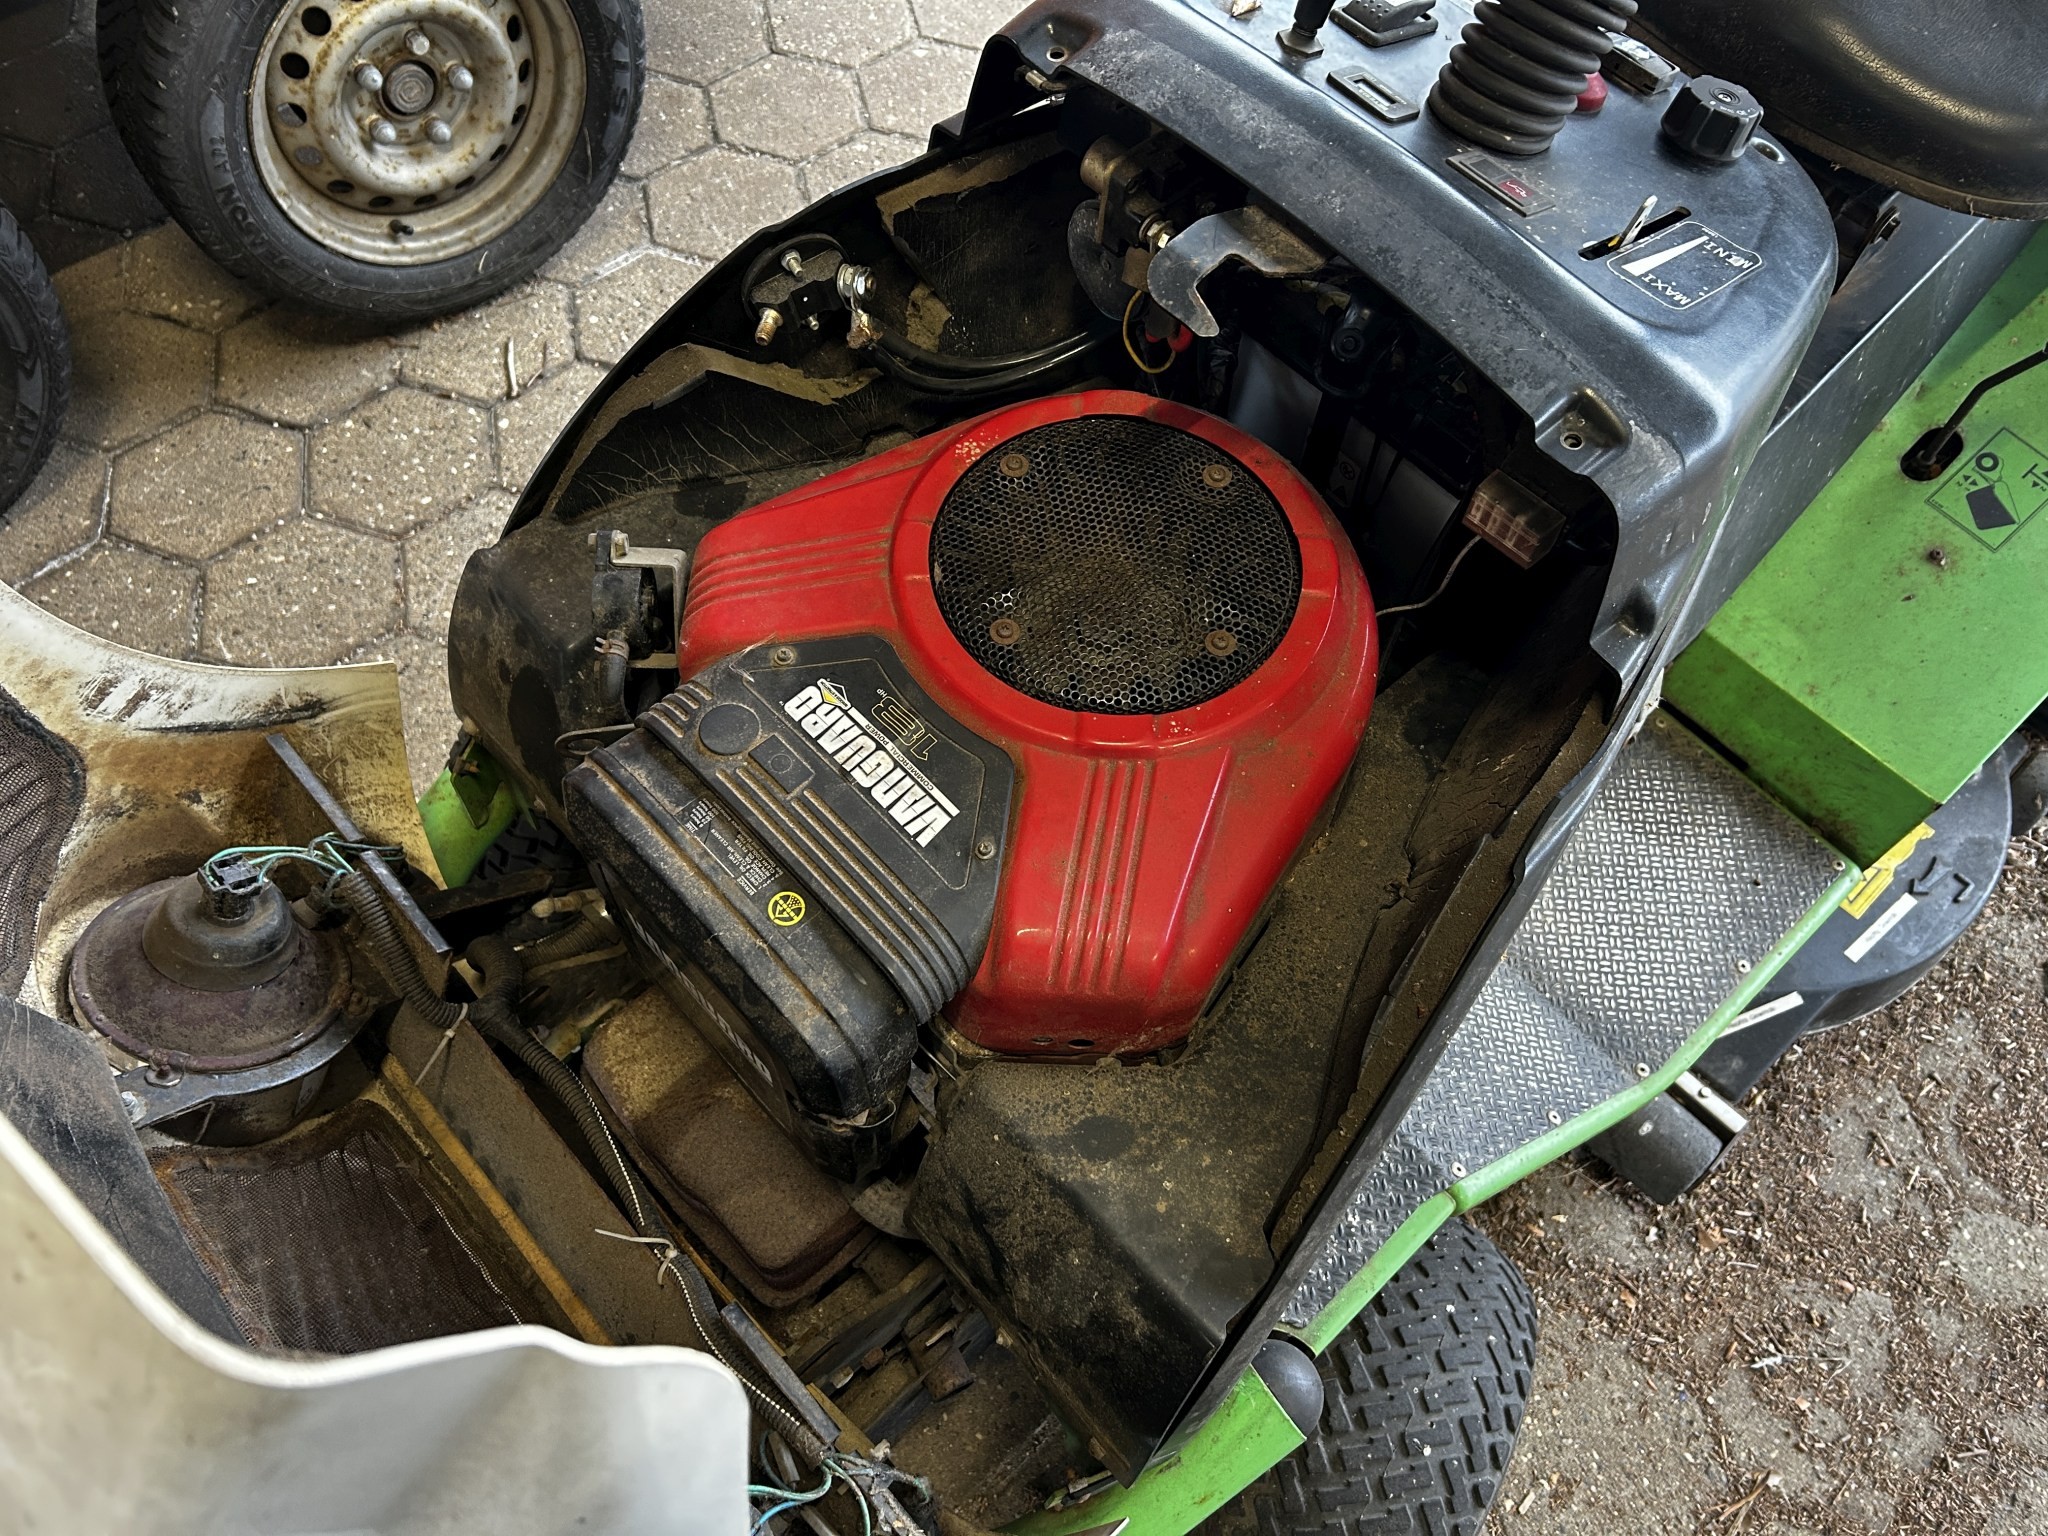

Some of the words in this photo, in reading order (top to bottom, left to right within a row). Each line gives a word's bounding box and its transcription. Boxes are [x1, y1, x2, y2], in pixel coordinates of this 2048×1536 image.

[1703, 240, 1753, 269] MINI
[1641, 273, 1691, 305] MAXI
[876, 688, 888, 697] HP
[864, 723, 889, 746] POWER
[872, 696, 938, 760] 18
[784, 685, 951, 848] VANGUARD
[889, 746, 934, 791] COMMERCIAL
[684, 821, 696, 833] TIME
[710, 827, 729, 846] CLEANER
[726, 852, 740, 865] LEVEL
[745, 842, 763, 860] COOLING
[748, 868, 763, 882] CHECK
[750, 863, 766, 879] CHANGE
[753, 859, 770, 876] REPLACE
[761, 859, 775, 873] CLEAN
[736, 876, 754, 895] SERVICE
[744, 871, 759, 886] CHECK
